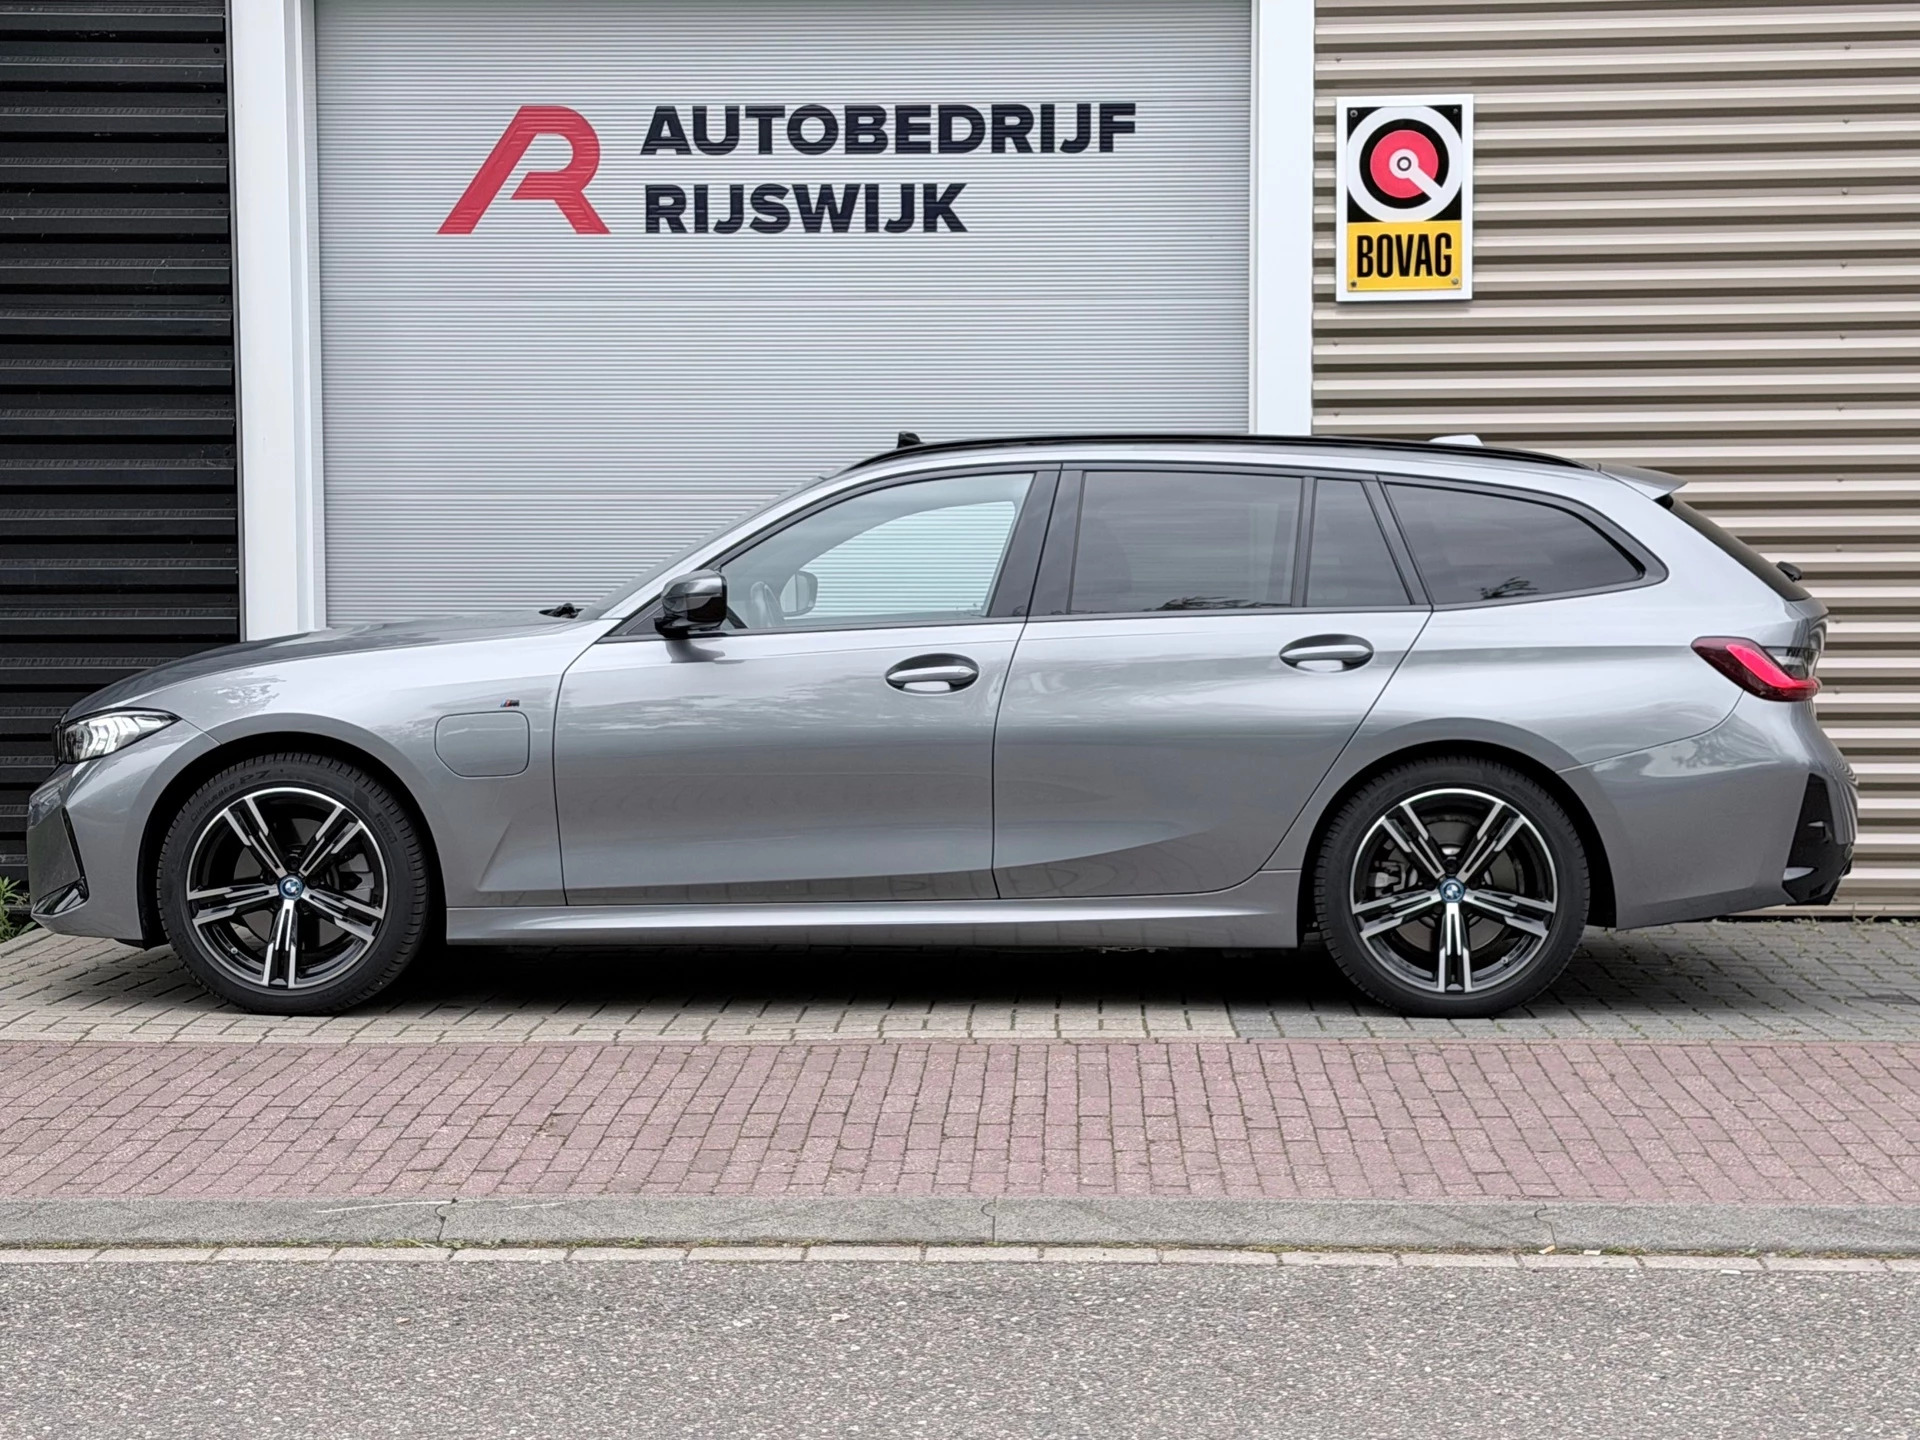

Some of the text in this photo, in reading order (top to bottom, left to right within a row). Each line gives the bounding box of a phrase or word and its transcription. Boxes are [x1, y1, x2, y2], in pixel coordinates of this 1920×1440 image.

[640, 103, 1137, 155] AUTOBEDRIJF
[644, 183, 968, 234] RIJSWIJK
[1356, 232, 1452, 278] BOVAG
